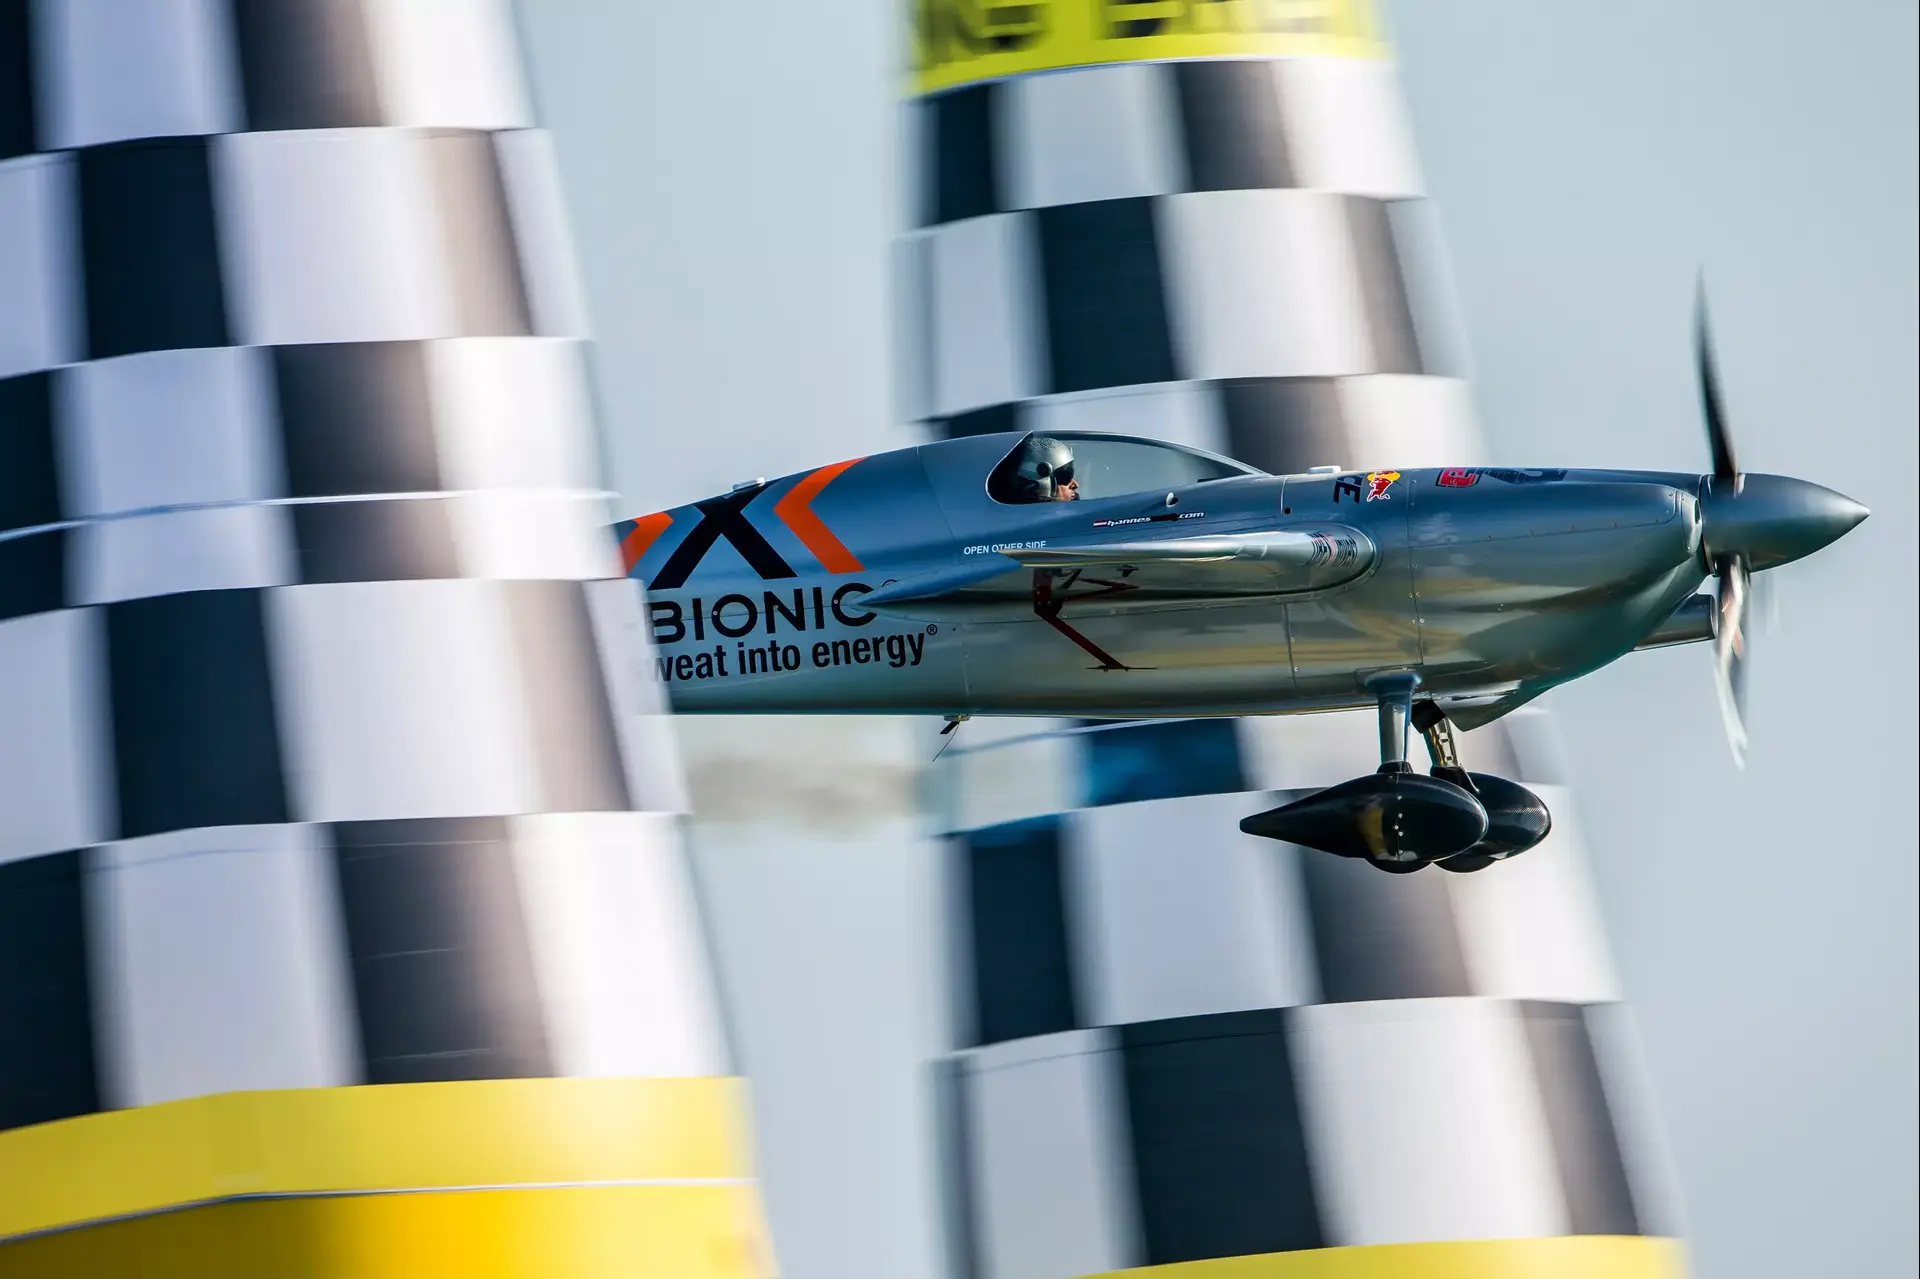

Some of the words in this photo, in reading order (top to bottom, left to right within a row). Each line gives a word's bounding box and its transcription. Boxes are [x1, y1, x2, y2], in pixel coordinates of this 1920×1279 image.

[963, 545, 989, 555] OPEN
[991, 542, 1024, 553] OTHER
[1025, 540, 1047, 550] SIDE
[737, 639, 801, 676] into
